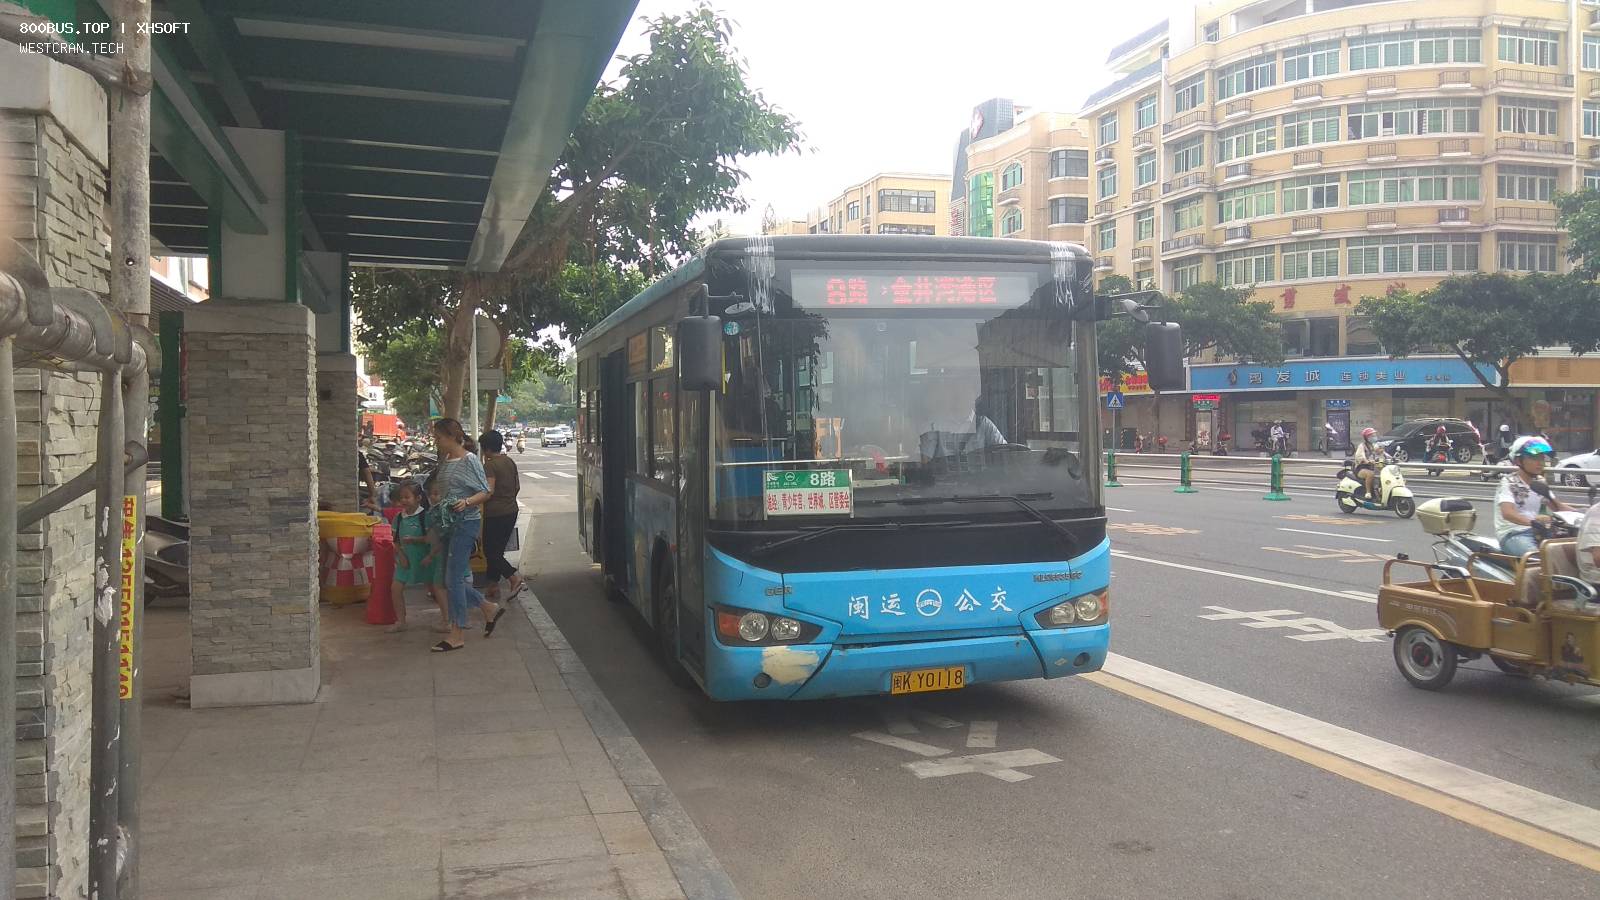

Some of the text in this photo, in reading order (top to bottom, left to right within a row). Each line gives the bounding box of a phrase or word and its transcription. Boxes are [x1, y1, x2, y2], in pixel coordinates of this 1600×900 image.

[810, 471, 836, 487] 8路
[848, 586, 1013, 620] 闽运 公交
